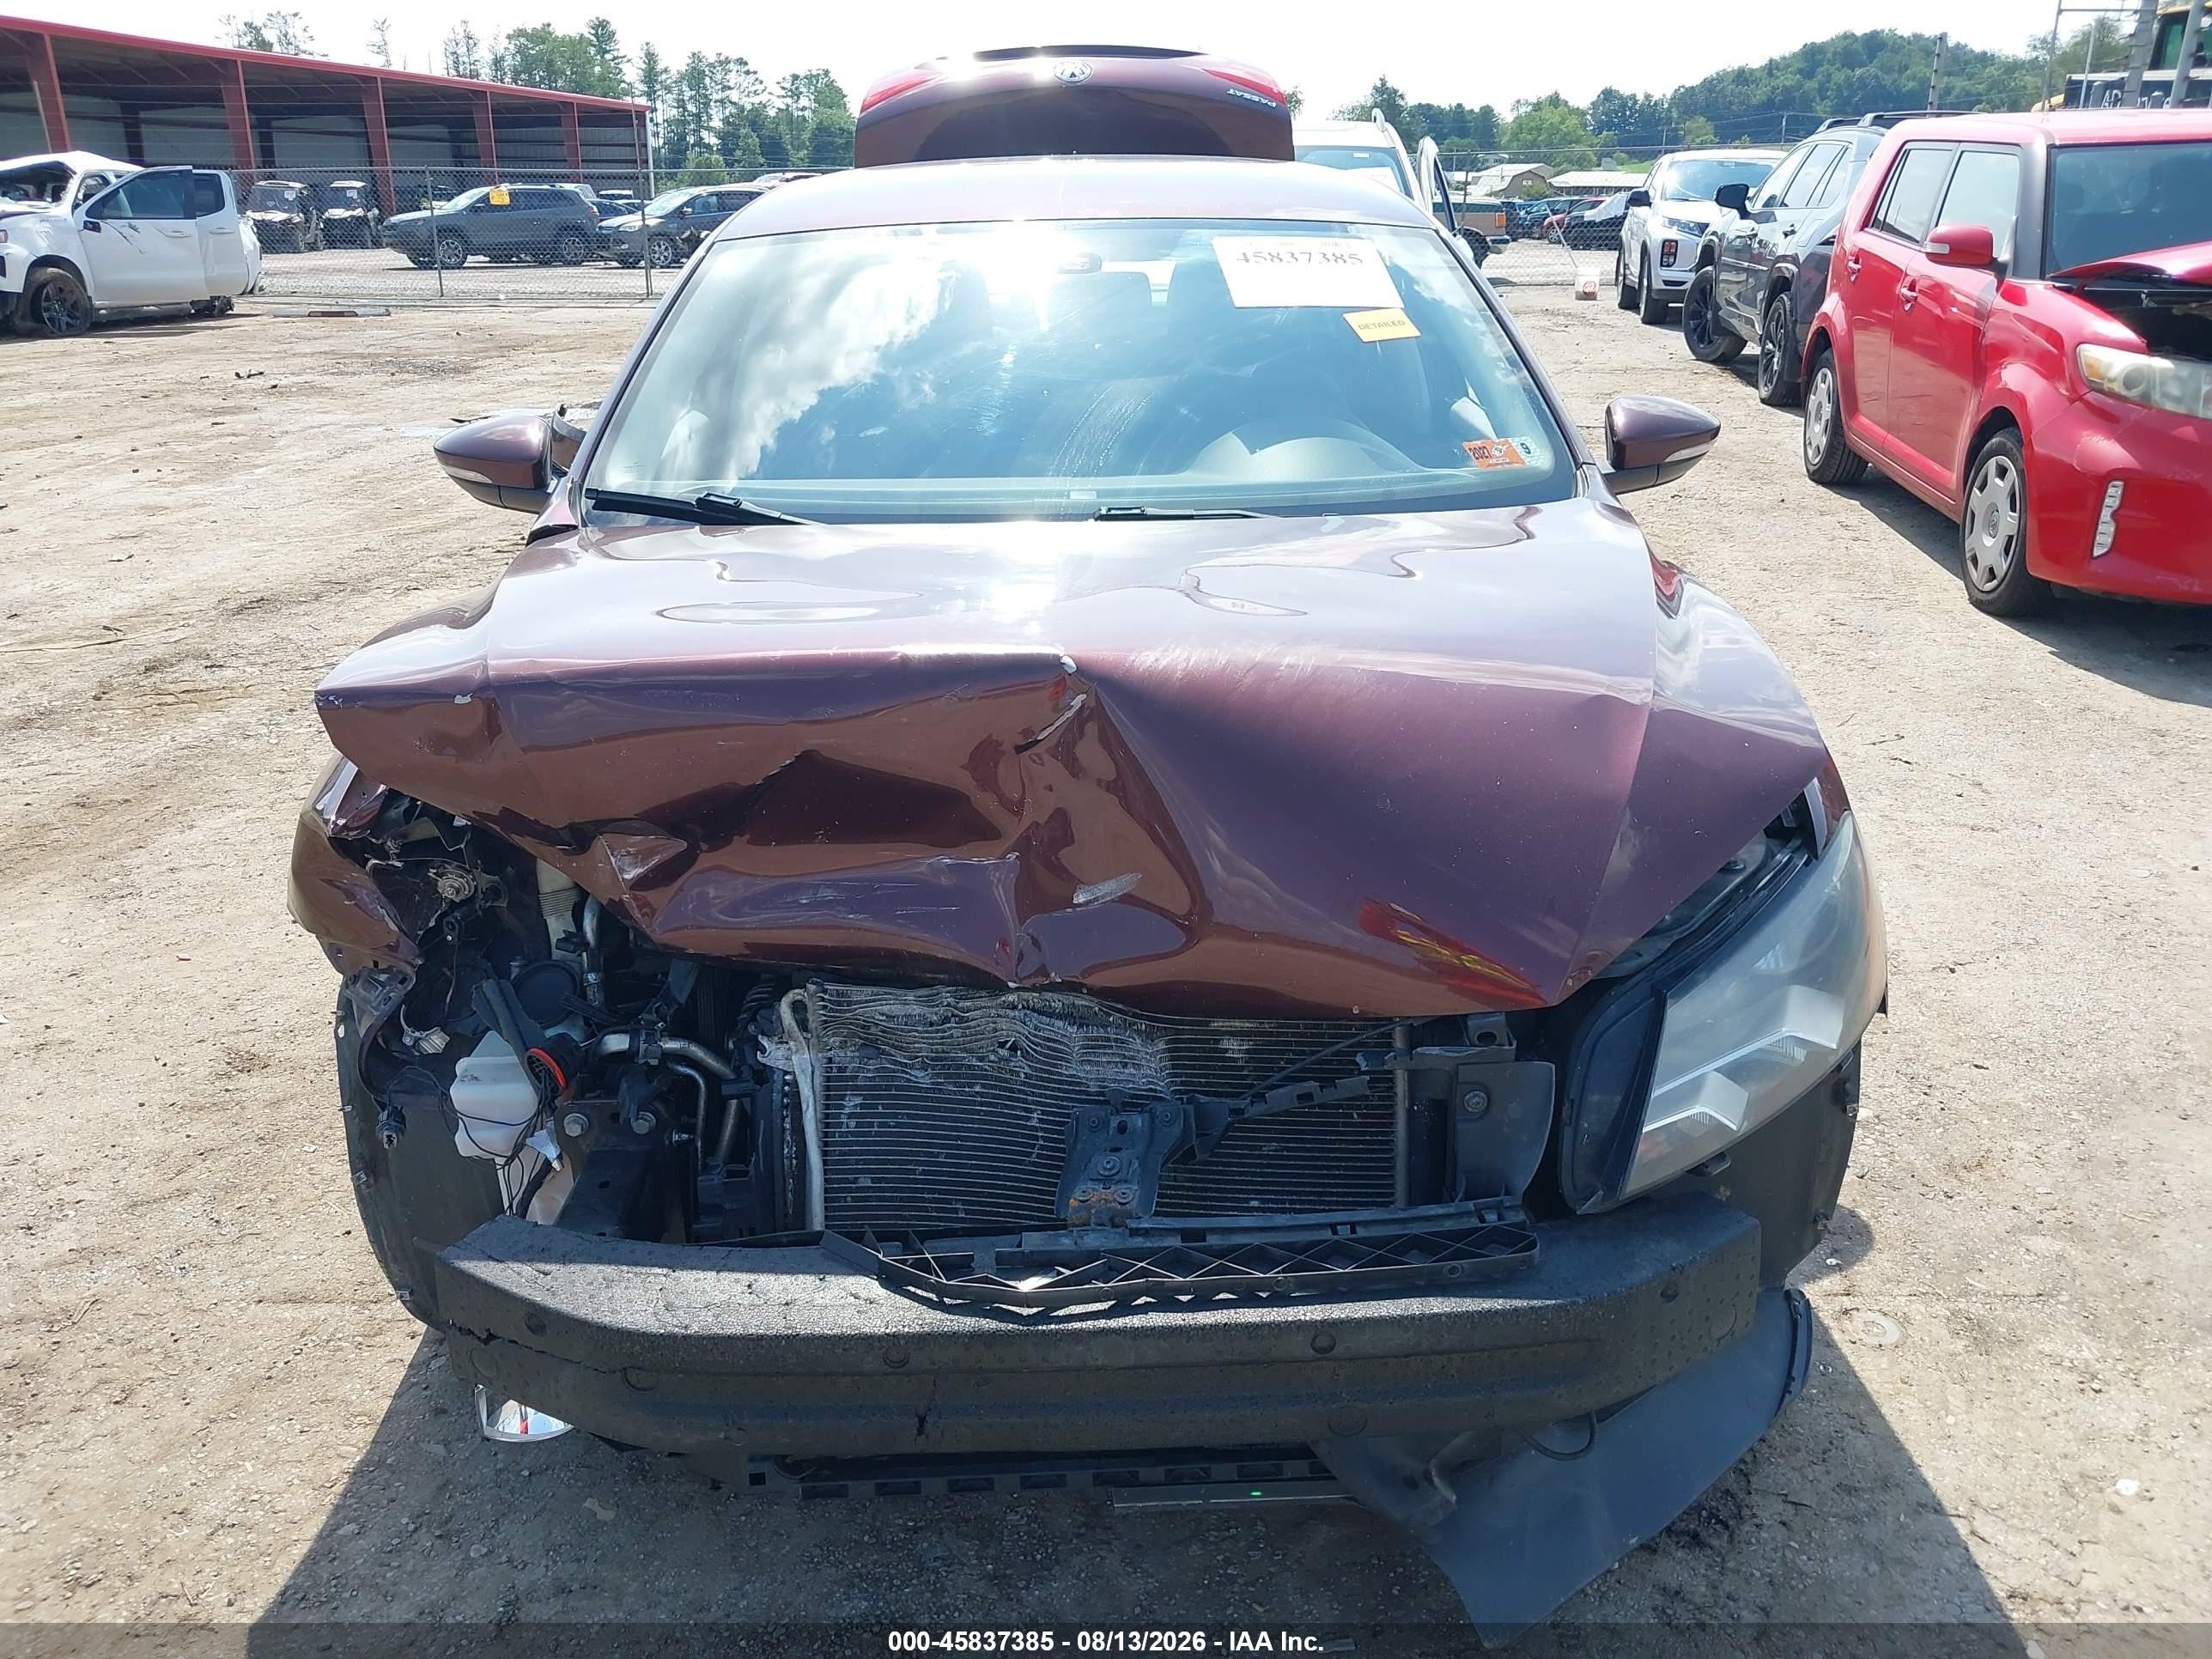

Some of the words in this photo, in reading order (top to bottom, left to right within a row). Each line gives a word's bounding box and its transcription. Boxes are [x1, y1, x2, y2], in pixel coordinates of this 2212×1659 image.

[1226, 88, 1277, 108] PASSAT
[1236, 251, 1364, 264] 45837385
[1358, 319, 1406, 331] DETAILED
[1468, 445, 1492, 461] 2027
